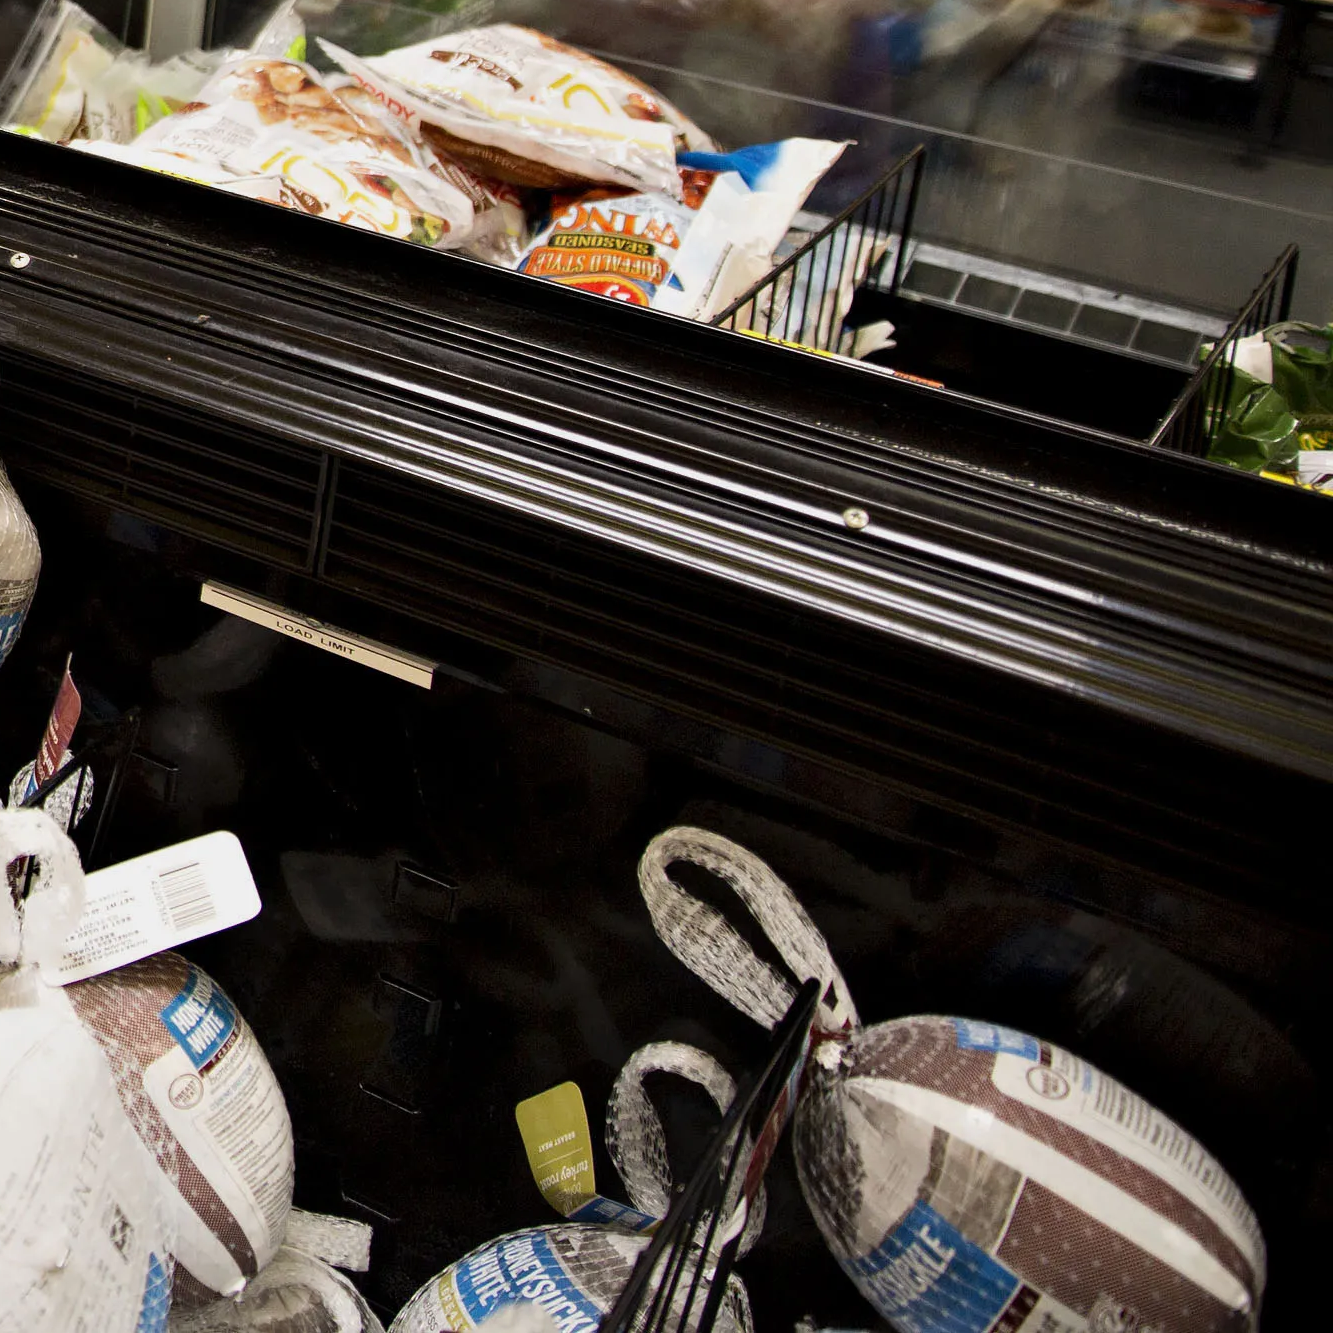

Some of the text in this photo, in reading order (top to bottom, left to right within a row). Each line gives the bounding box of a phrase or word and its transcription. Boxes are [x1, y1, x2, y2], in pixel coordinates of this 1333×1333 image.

[554, 235, 650, 256] SEASONED
[535, 252, 586, 274] STYLE
[275, 619, 356, 657] LOAD LIMIT
[187, 1009, 225, 1055] WHITE
[560, 1160, 590, 1181] turkey
[469, 1248, 511, 1306] WHITE
